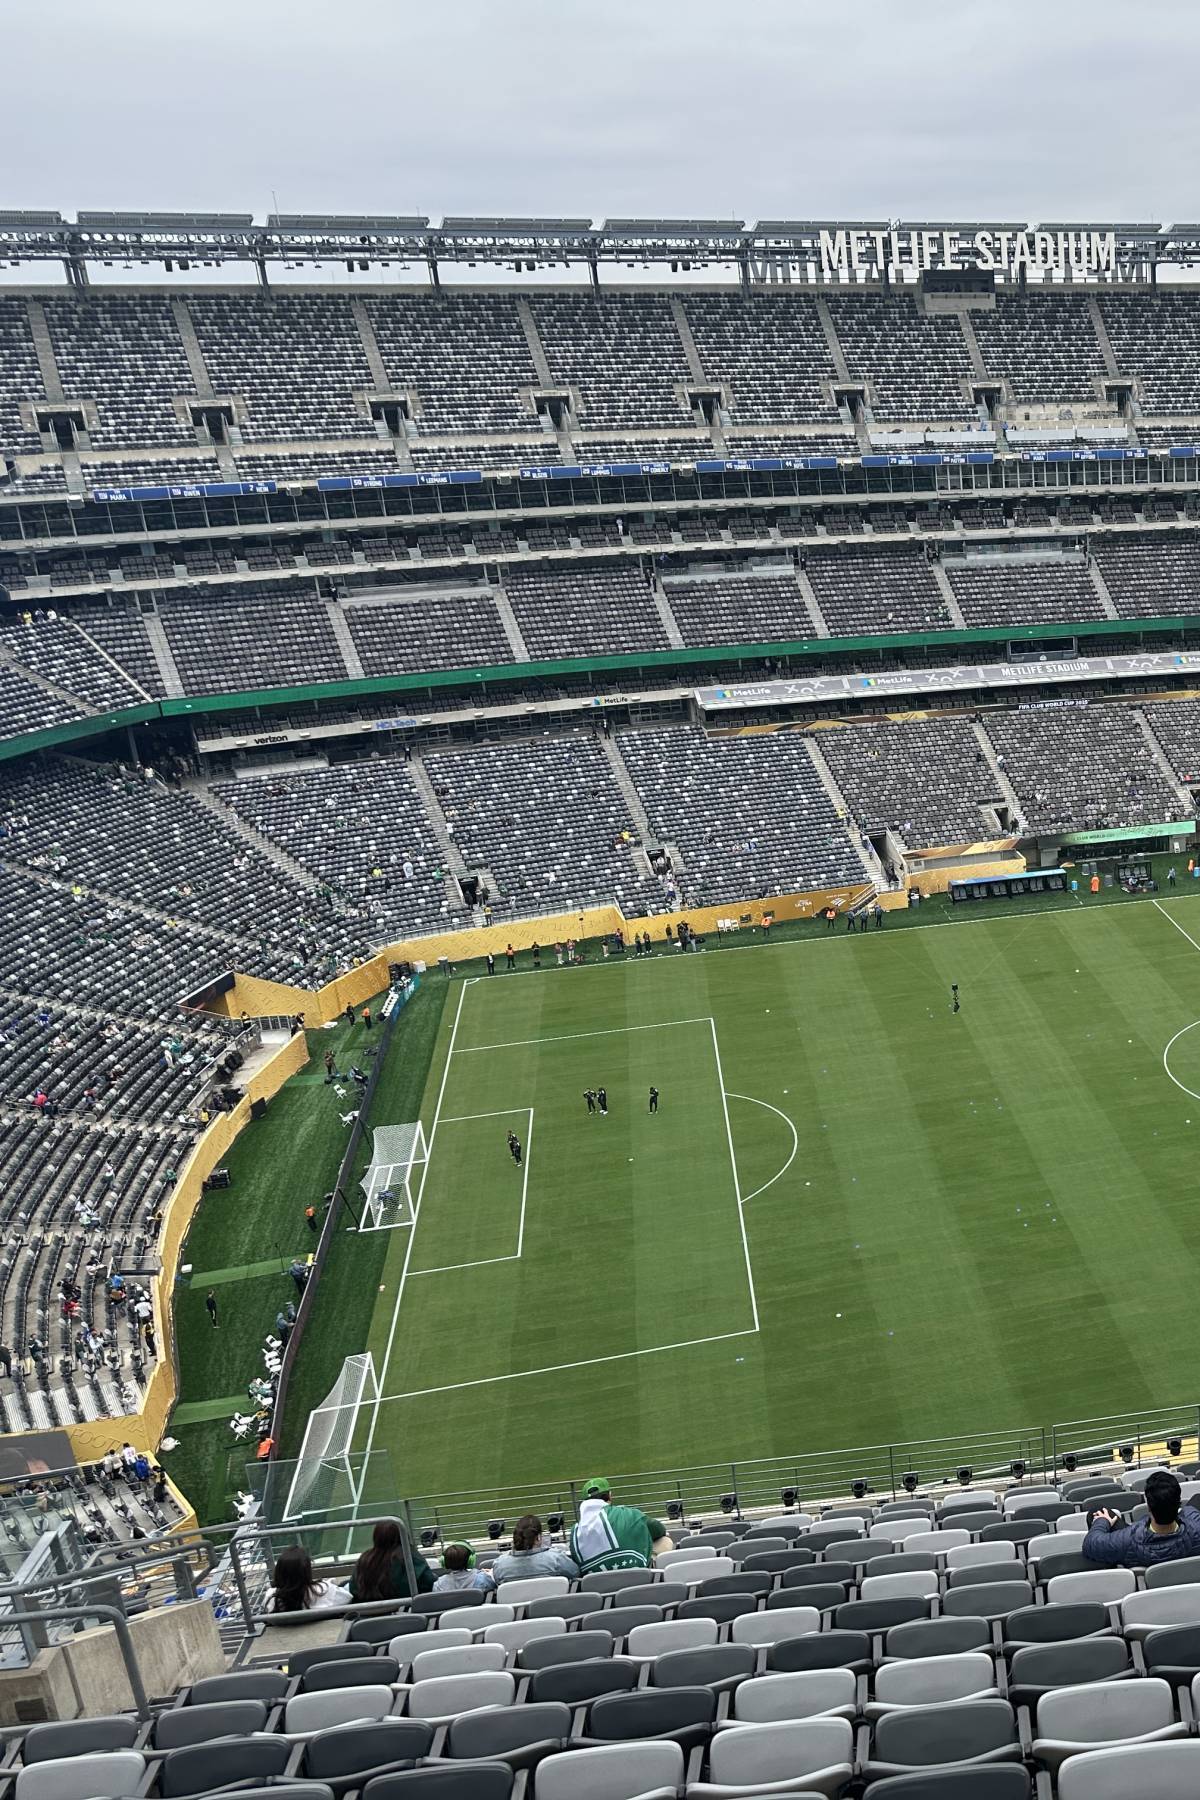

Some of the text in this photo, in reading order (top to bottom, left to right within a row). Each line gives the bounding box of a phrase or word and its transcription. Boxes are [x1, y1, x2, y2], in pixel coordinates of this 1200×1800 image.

[819, 230, 1116, 271] METLIFE STADIUM
[1001, 661, 1090, 677] METLIFE STADIUM
[877, 675, 913, 686] MetLife
[733, 686, 771, 698] MetLife
[603, 696, 628, 705] MetLife
[254, 733, 289, 745] verizon
